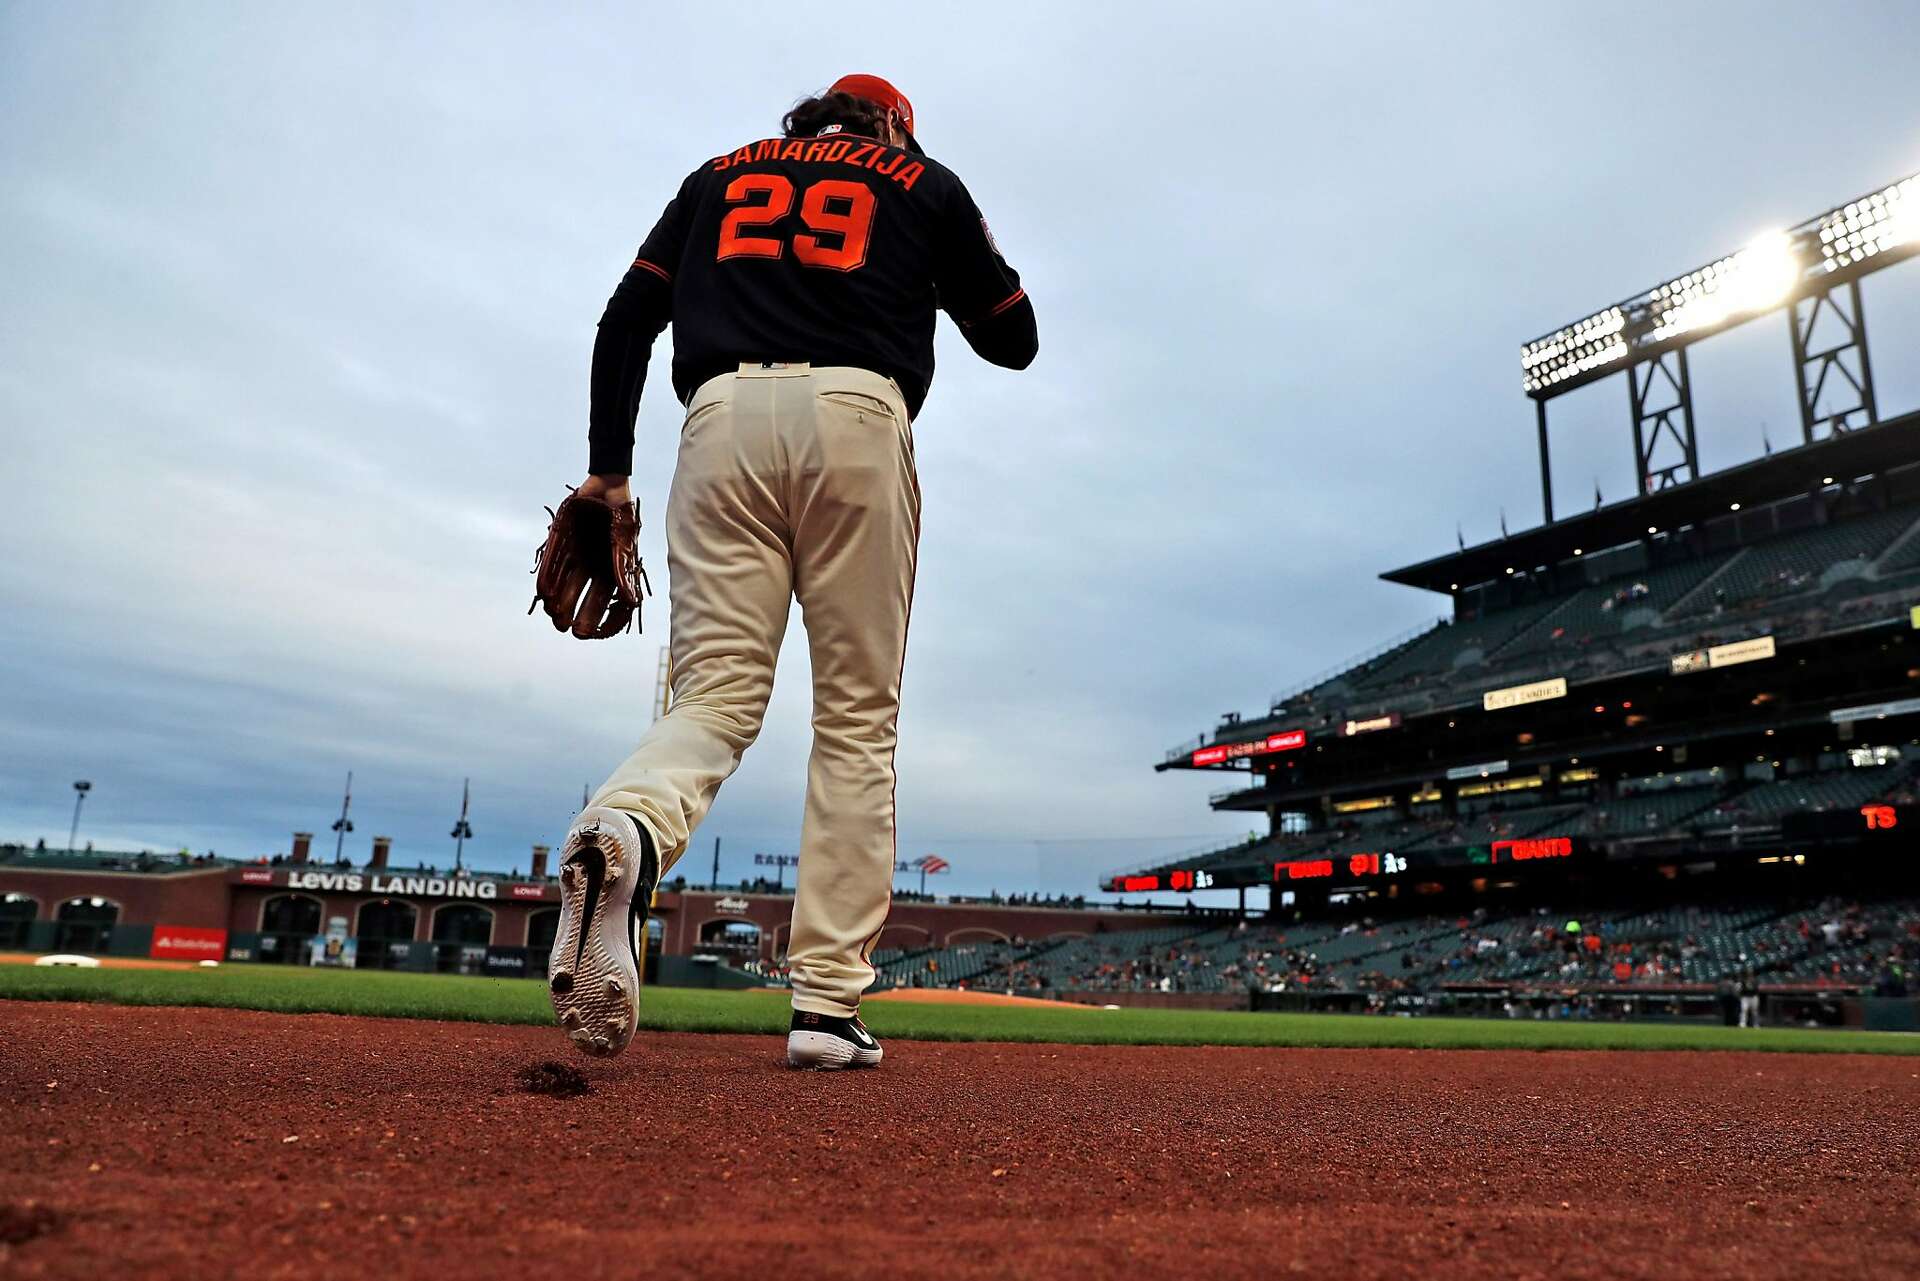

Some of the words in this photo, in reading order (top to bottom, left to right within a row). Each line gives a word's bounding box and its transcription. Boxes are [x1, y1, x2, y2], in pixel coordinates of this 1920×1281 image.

[716, 173, 878, 272] 29
[371, 876, 496, 898] LANDING
[803, 1013, 819, 1024] 29
